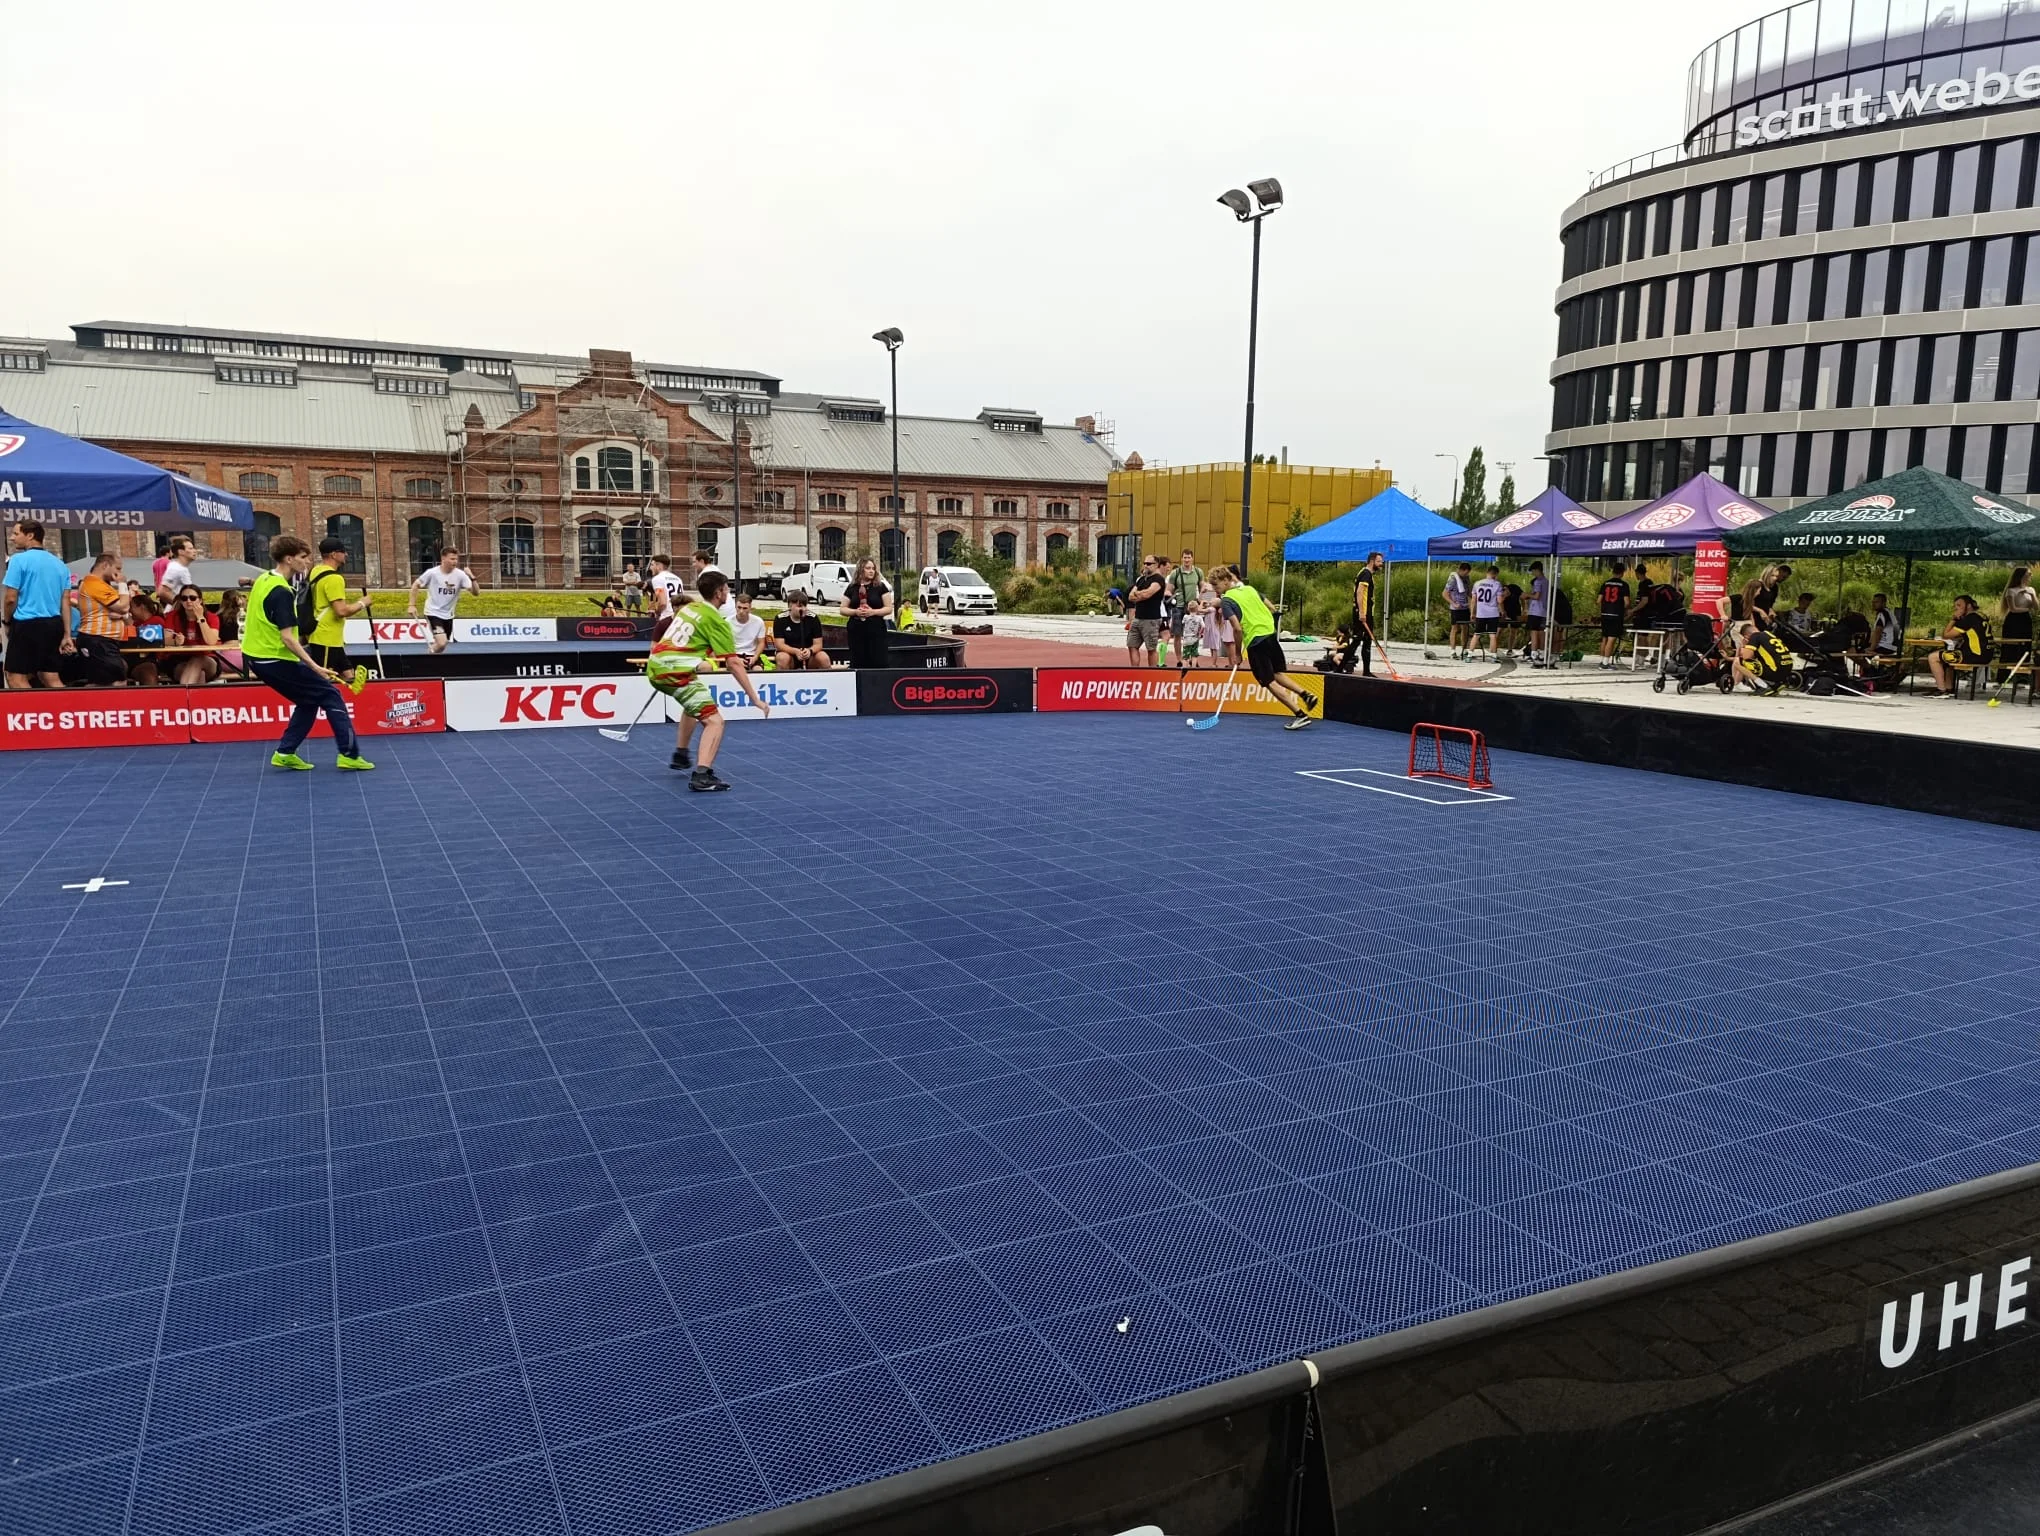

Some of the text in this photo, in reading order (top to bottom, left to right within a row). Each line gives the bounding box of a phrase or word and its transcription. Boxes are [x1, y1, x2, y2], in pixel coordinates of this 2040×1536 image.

[1798, 509, 1904, 524] HOLBA
[1601, 538, 1665, 550] ČESKÝ FLORBAL
[1783, 534, 1886, 546] RYZÍ PIVO Z HOR
[1707, 549, 1728, 558] KFC
[1478, 587, 1492, 603] 20
[1605, 586, 1618, 602] 13
[369, 622, 428, 641] KFC
[470, 623, 541, 637] deník.cz
[583, 625, 630, 635] BigBoard
[926, 656, 947, 668] UHER
[516, 664, 566, 677] UHER
[905, 686, 986, 703] BigBoard
[1061, 681, 1083, 699] NO
[1085, 681, 1141, 700] POWER
[1144, 681, 1180, 700] LIKE
[1181, 682, 1241, 701] WOMEN
[500, 683, 616, 723] KFC
[7, 712, 54, 731] KFC
[59, 710, 144, 730] STREET
[149, 706, 274, 727] FLOORBALL
[1879, 1256, 2031, 1369] UHE
